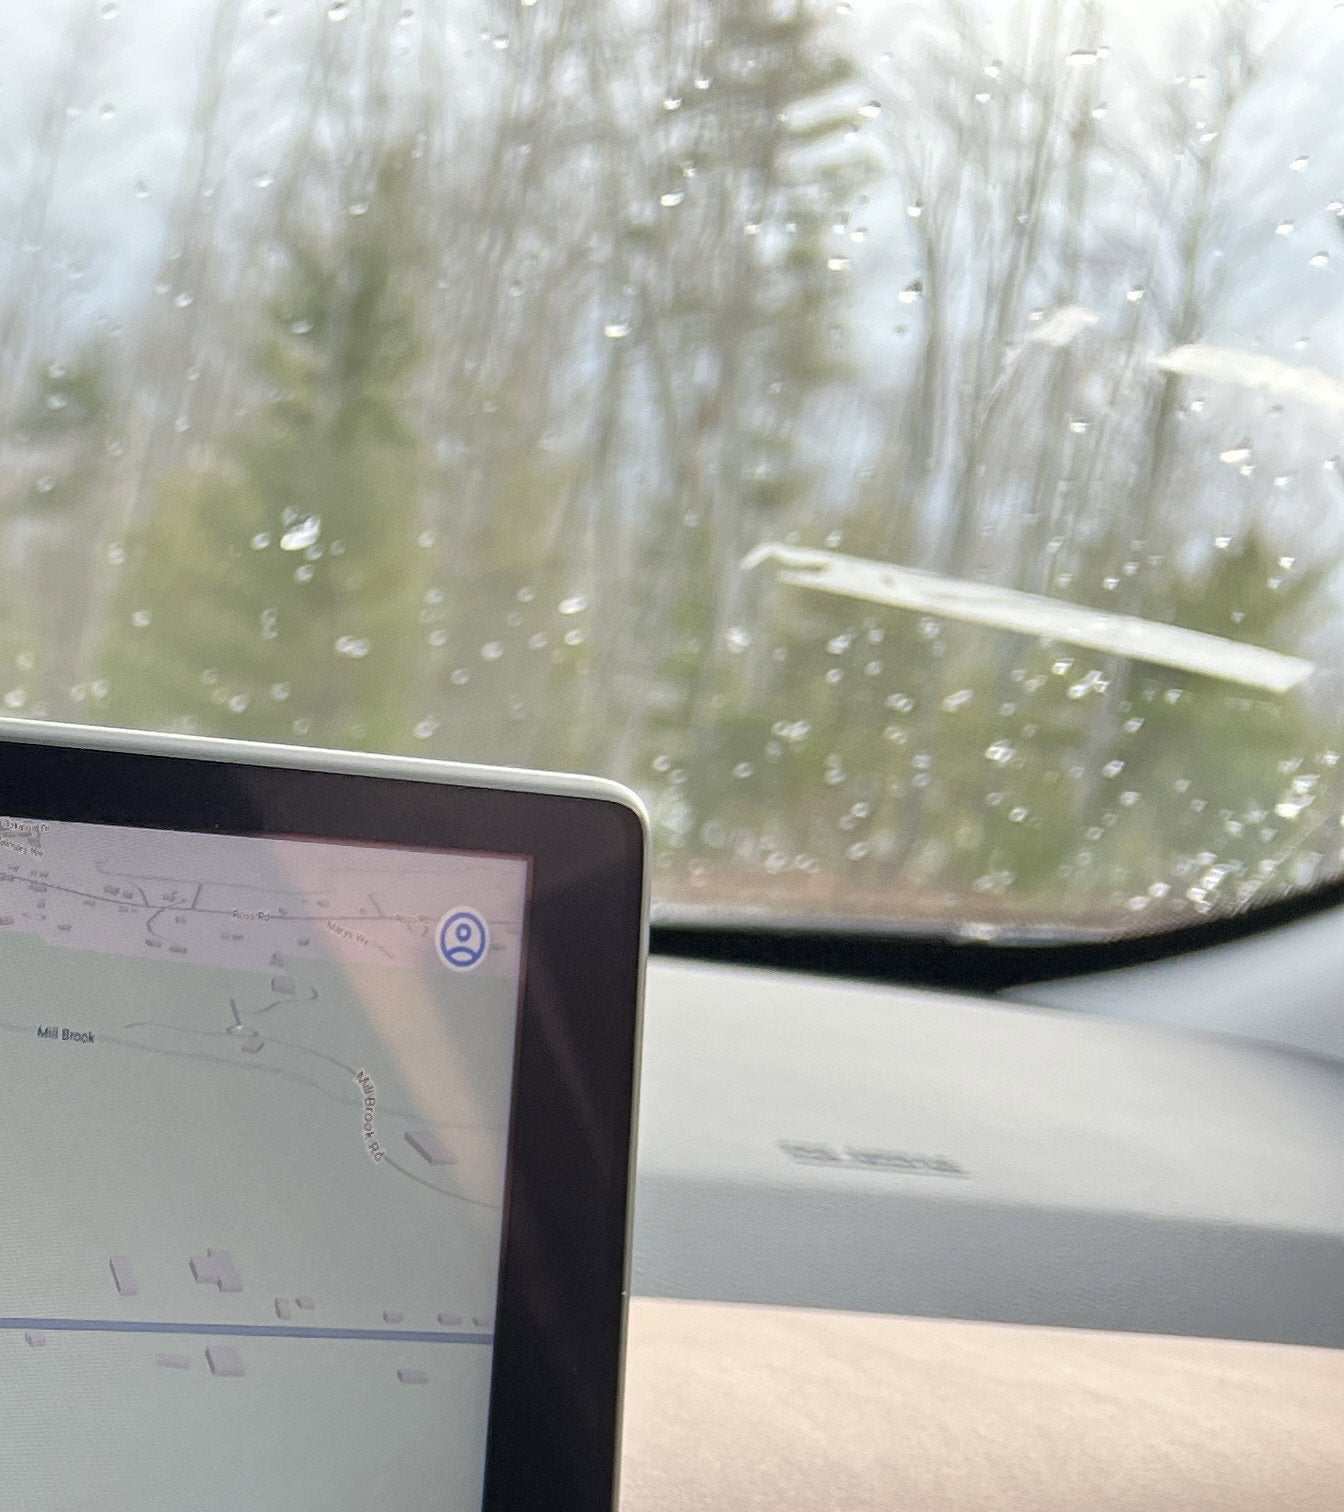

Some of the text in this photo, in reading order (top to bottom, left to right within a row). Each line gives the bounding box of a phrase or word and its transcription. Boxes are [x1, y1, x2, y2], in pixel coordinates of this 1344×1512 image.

[36, 1026, 96, 1044] Mill Brook
[355, 1070, 375, 1095] Mill
[363, 1097, 376, 1139] Brook
